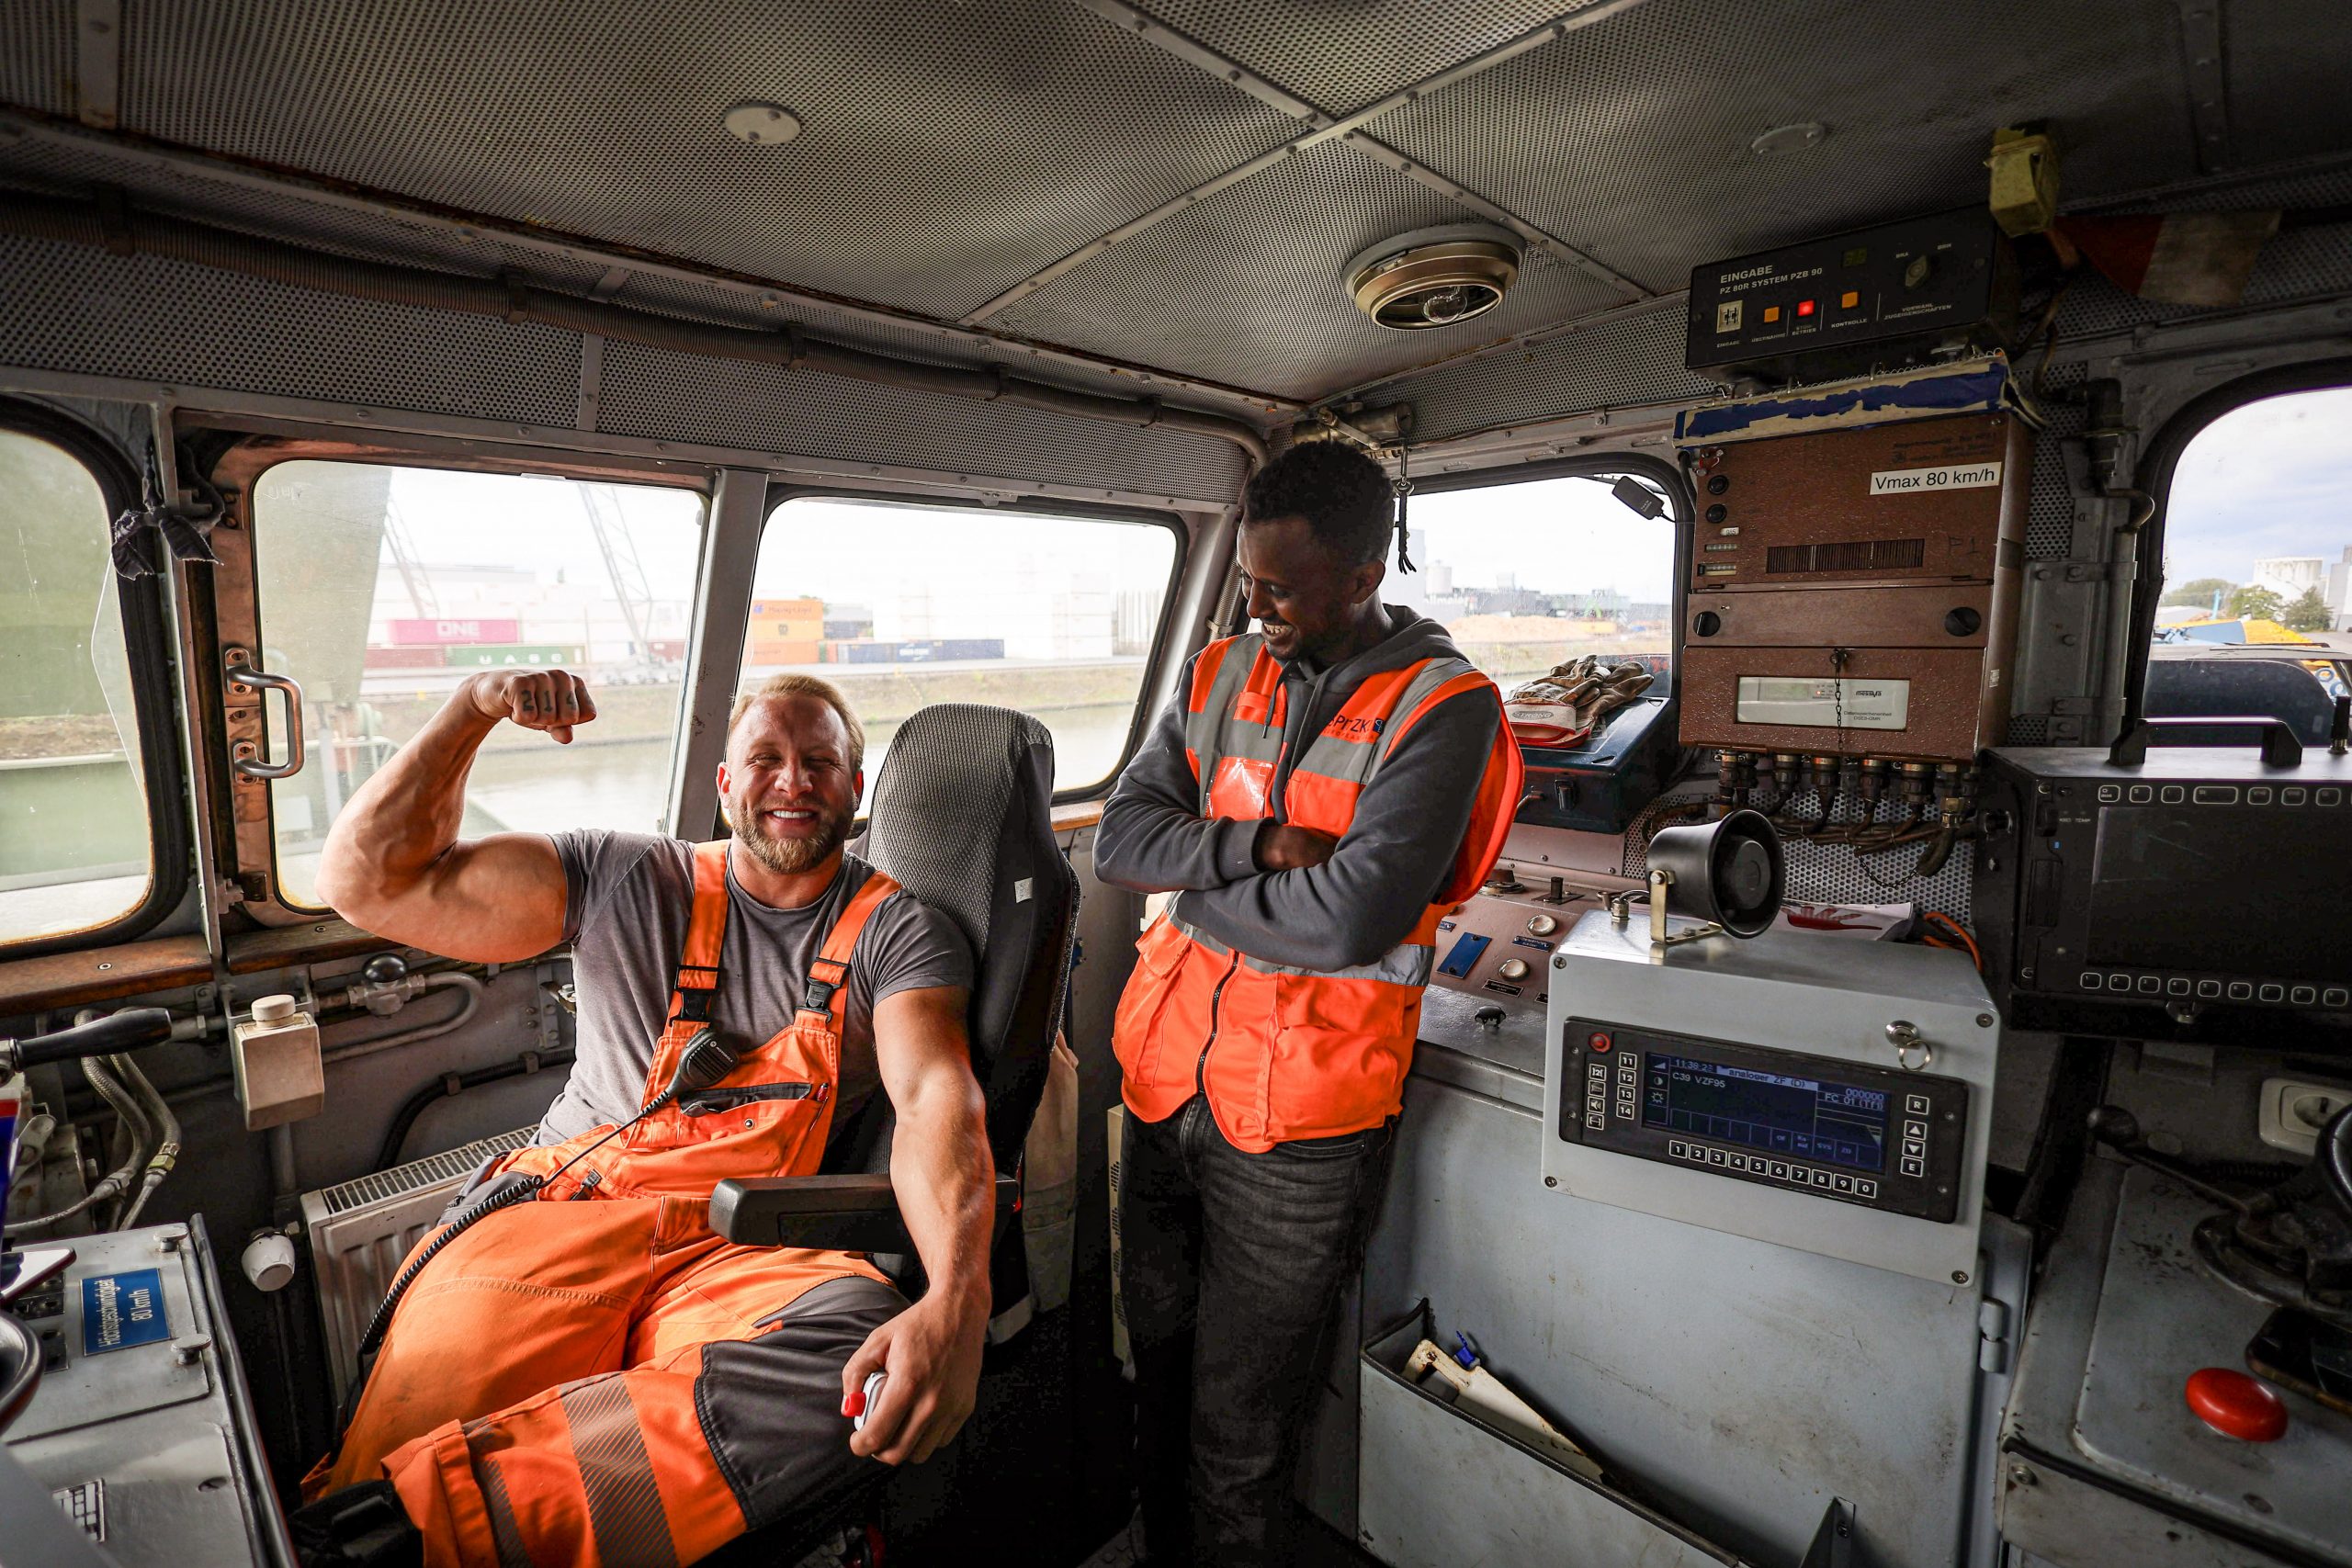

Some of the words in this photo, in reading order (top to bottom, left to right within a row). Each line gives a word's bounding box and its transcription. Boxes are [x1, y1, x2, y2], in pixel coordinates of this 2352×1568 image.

[1720, 265, 1773, 284] EINGABE
[1719, 287, 1731, 295] PZ
[1733, 282, 1749, 292] 80R
[1751, 275, 1788, 288] SYSTEM
[1790, 270, 1809, 280] PZB
[1811, 267, 1823, 276] 90
[1831, 318, 1868, 328] KONTROLLE
[1876, 476, 1921, 490] Vmax
[1926, 471, 1948, 486] 80
[1952, 468, 1995, 484] km/h
[436, 621, 481, 637] ONE
[1623, 1056, 1633, 1066] 11
[1622, 1073, 1633, 1082] 12
[1672, 1072, 1690, 1082] C39
[1694, 1075, 1726, 1089] VZF95
[1773, 1077, 1786, 1085] ZF
[1791, 1078, 1805, 1088] (D)
[1621, 1089, 1632, 1099] 13
[1825, 1092, 1838, 1102] FC
[1913, 1100, 1922, 1110] R
[1620, 1106, 1631, 1115] 14
[1675, 1145, 1680, 1154] 1
[1755, 1162, 1761, 1170] 5
[1908, 1163, 1916, 1171] E
[1796, 1170, 1804, 1179] 7
[1839, 1179, 1848, 1188] 9
[1861, 1184, 1870, 1192] 0
[129, 1288, 152, 1310] km/h
[94, 1278, 124, 1348] Höchstgeschwindigkeit
[130, 1309, 153, 1321] 80
